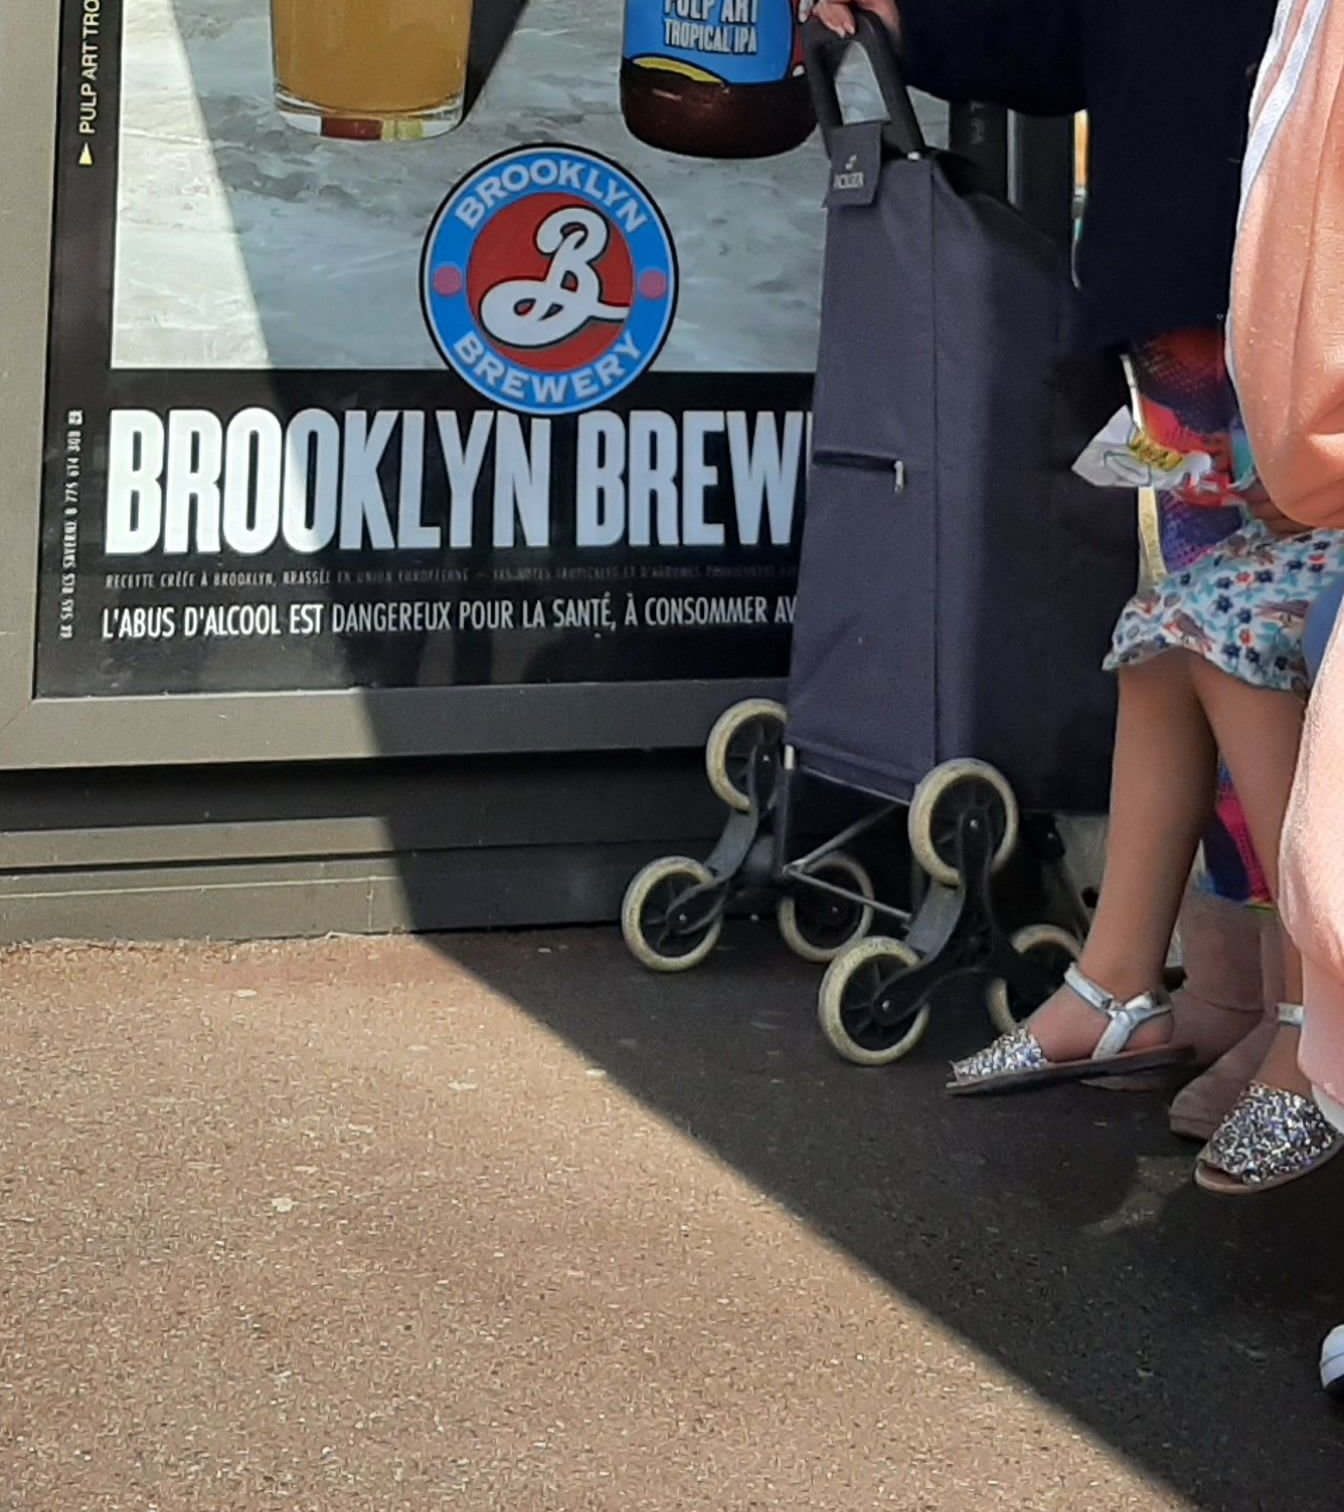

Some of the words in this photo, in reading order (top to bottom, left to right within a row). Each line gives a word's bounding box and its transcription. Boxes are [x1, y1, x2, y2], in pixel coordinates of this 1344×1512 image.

[81, 41, 99, 81] ART
[663, 19, 733, 53] TROPICAL
[733, 26, 758, 54] IPA
[79, 83, 98, 135] PULP
[455, 158, 648, 233] BROOKLYN
[453, 331, 641, 403] BREWERY
[105, 407, 551, 555] BROOKLYN
[576, 409, 813, 548] BREW
[102, 606, 175, 638] L'ABUS
[184, 604, 281, 637] D'ALCOOL
[289, 603, 323, 634] EST
[332, 601, 452, 633] DANGEREUX
[459, 599, 514, 630] POUR
[522, 599, 546, 628] LA
[552, 591, 616, 631] SANTÉ,
[624, 592, 639, 627] À
[645, 595, 768, 626] CONSOMMER
